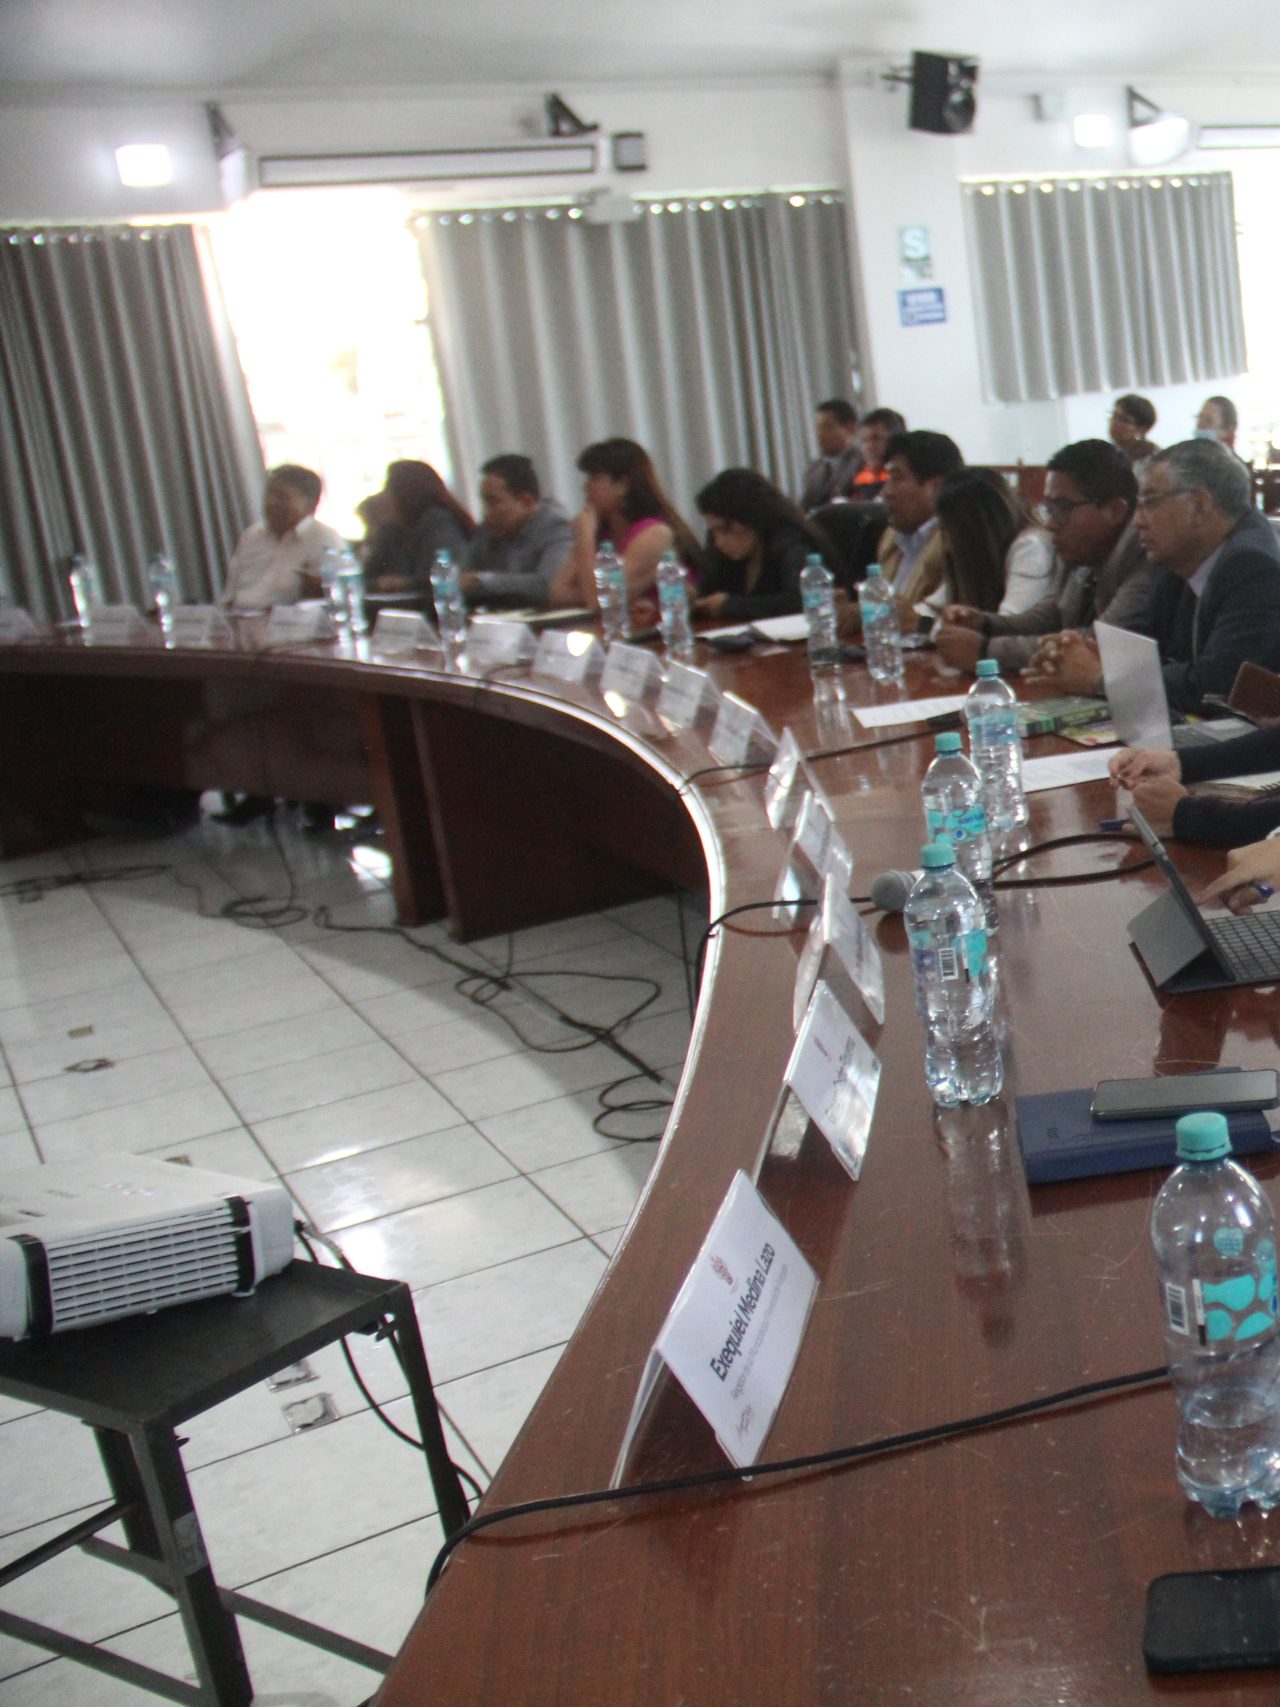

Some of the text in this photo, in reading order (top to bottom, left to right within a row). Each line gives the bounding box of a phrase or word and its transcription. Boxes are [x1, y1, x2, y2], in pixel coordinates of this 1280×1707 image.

[903, 228, 926, 257] S
[710, 1309, 749, 1382] Exequiel
[738, 1267, 766, 1318] Medina
[757, 1241, 775, 1275] Lazo
